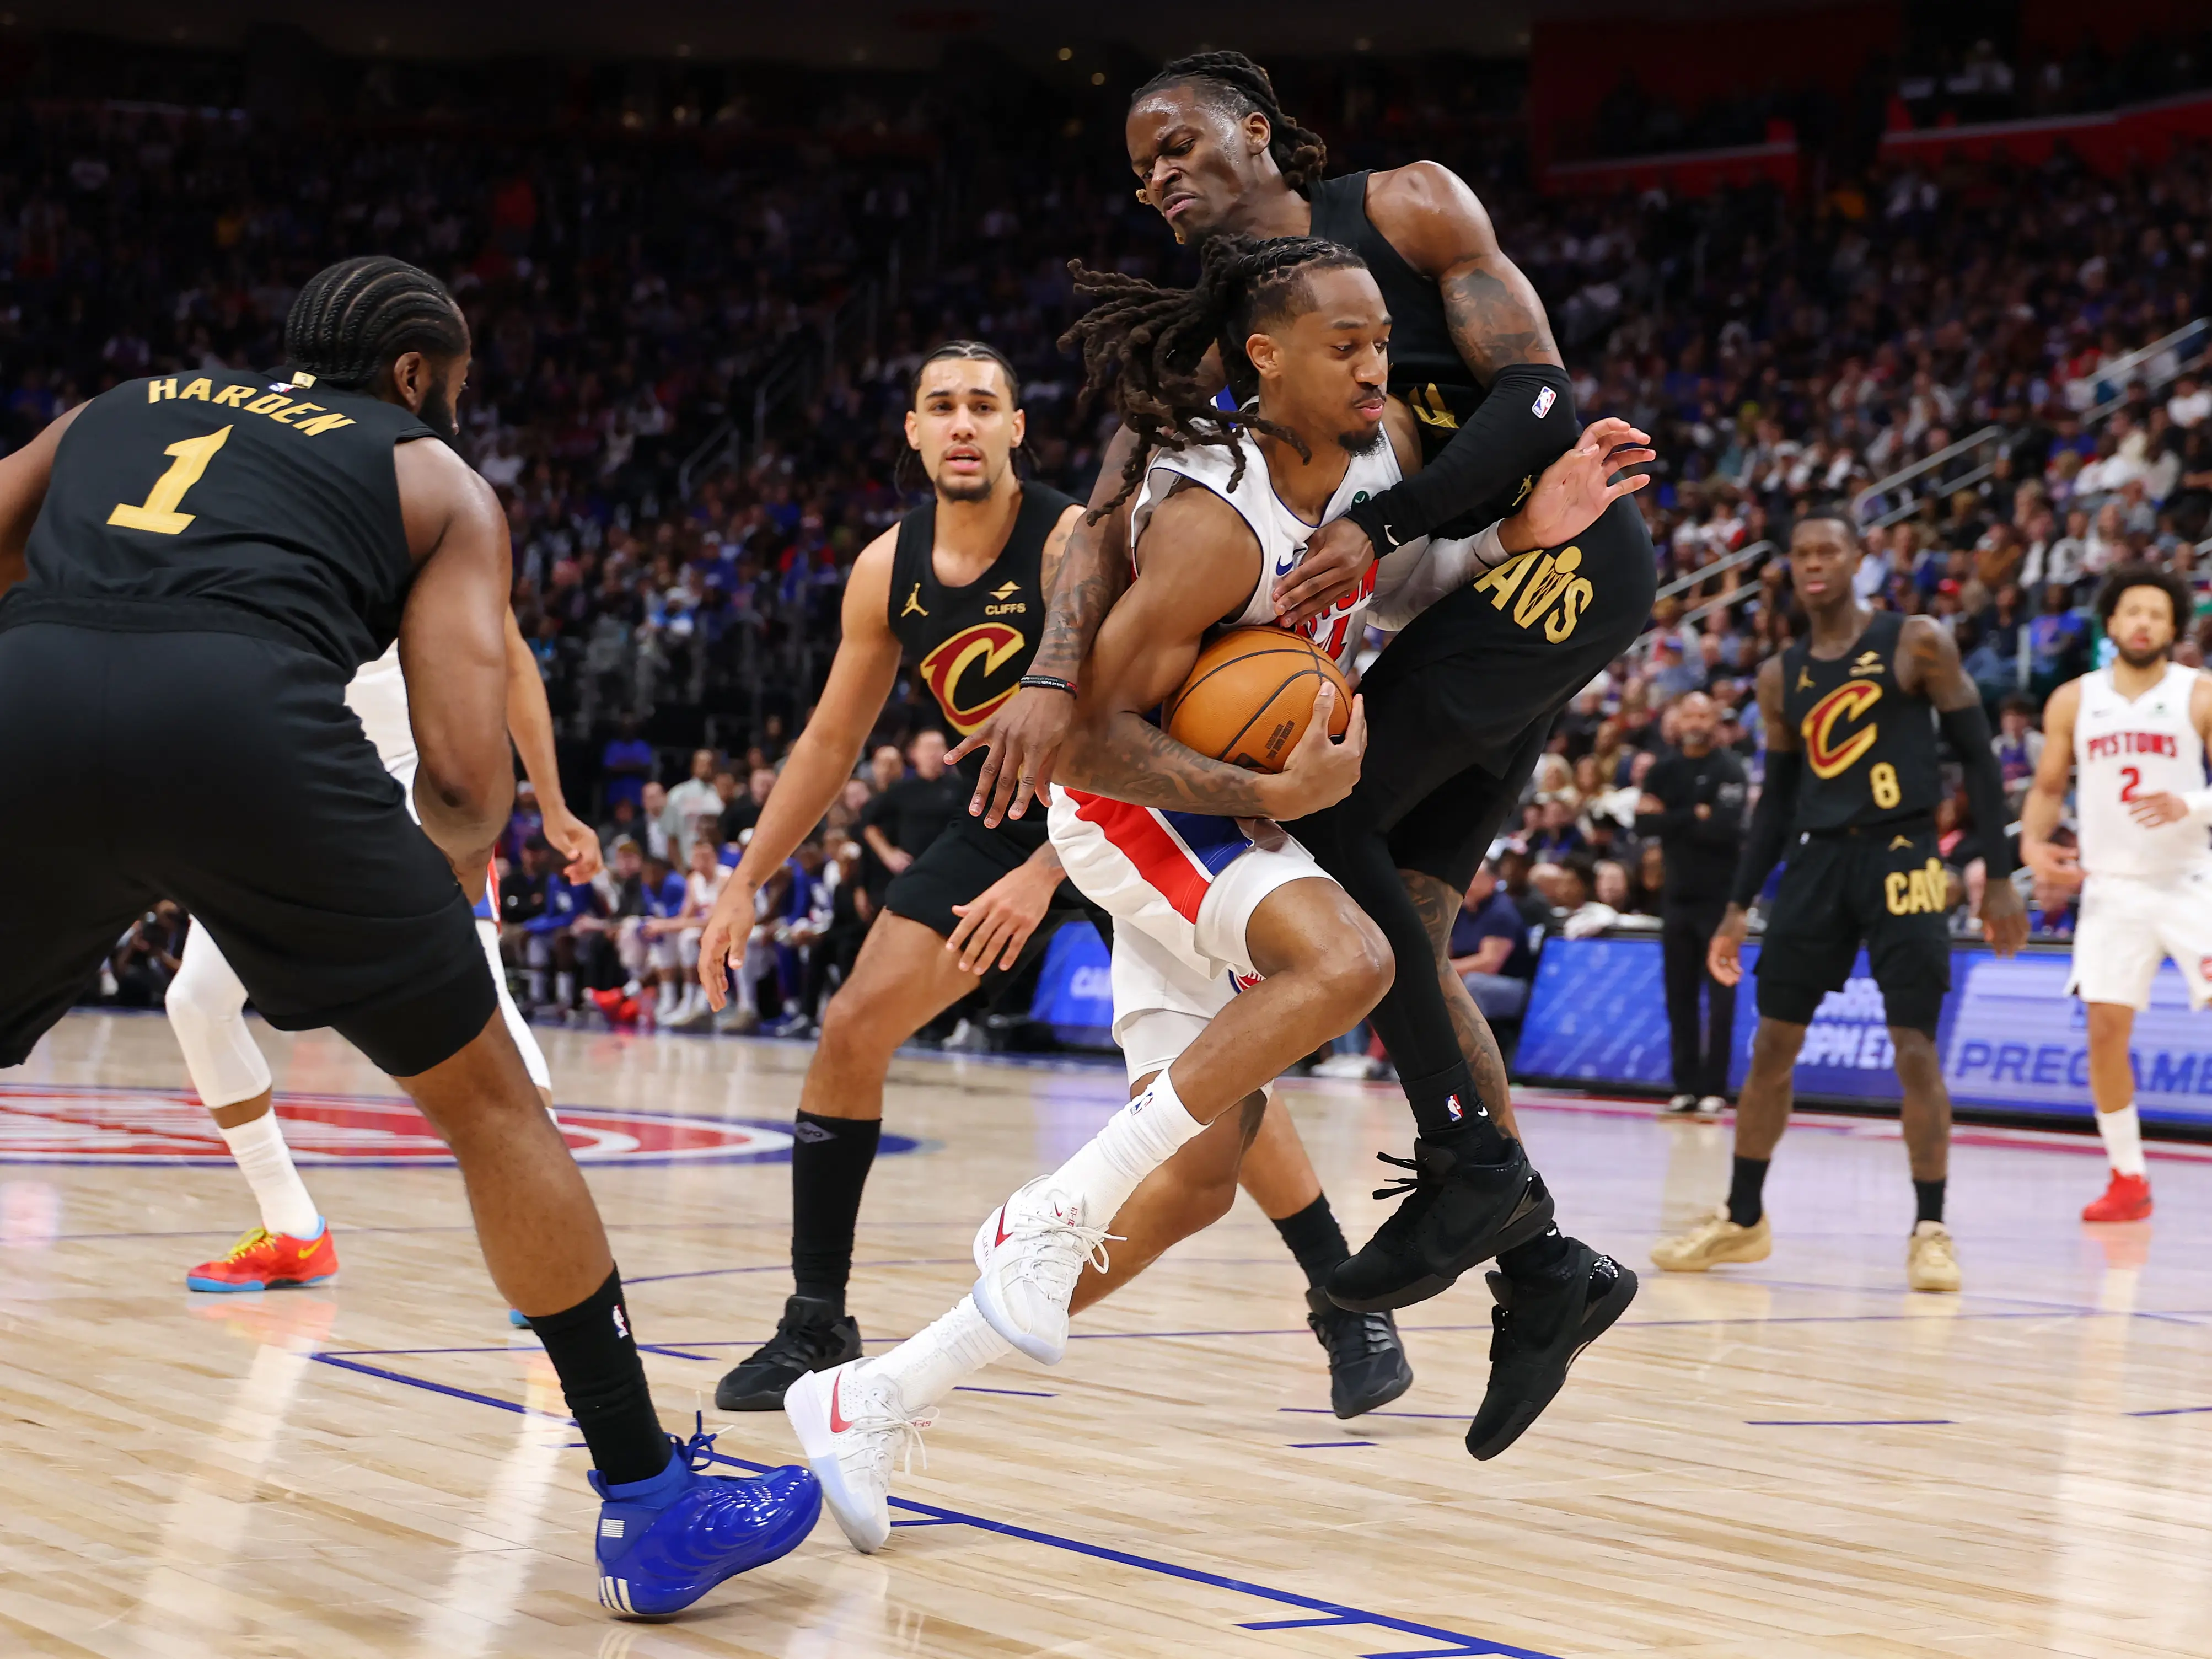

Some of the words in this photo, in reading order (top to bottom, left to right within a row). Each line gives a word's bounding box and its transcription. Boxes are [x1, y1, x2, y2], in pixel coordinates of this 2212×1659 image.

[148, 378, 357, 436] HARDEN
[106, 424, 234, 535] 1
[985, 603, 1027, 615] CLIFFS
[1473, 546, 1594, 645] AVS
[1870, 762, 1902, 809] 8
[2120, 767, 2140, 803] 2
